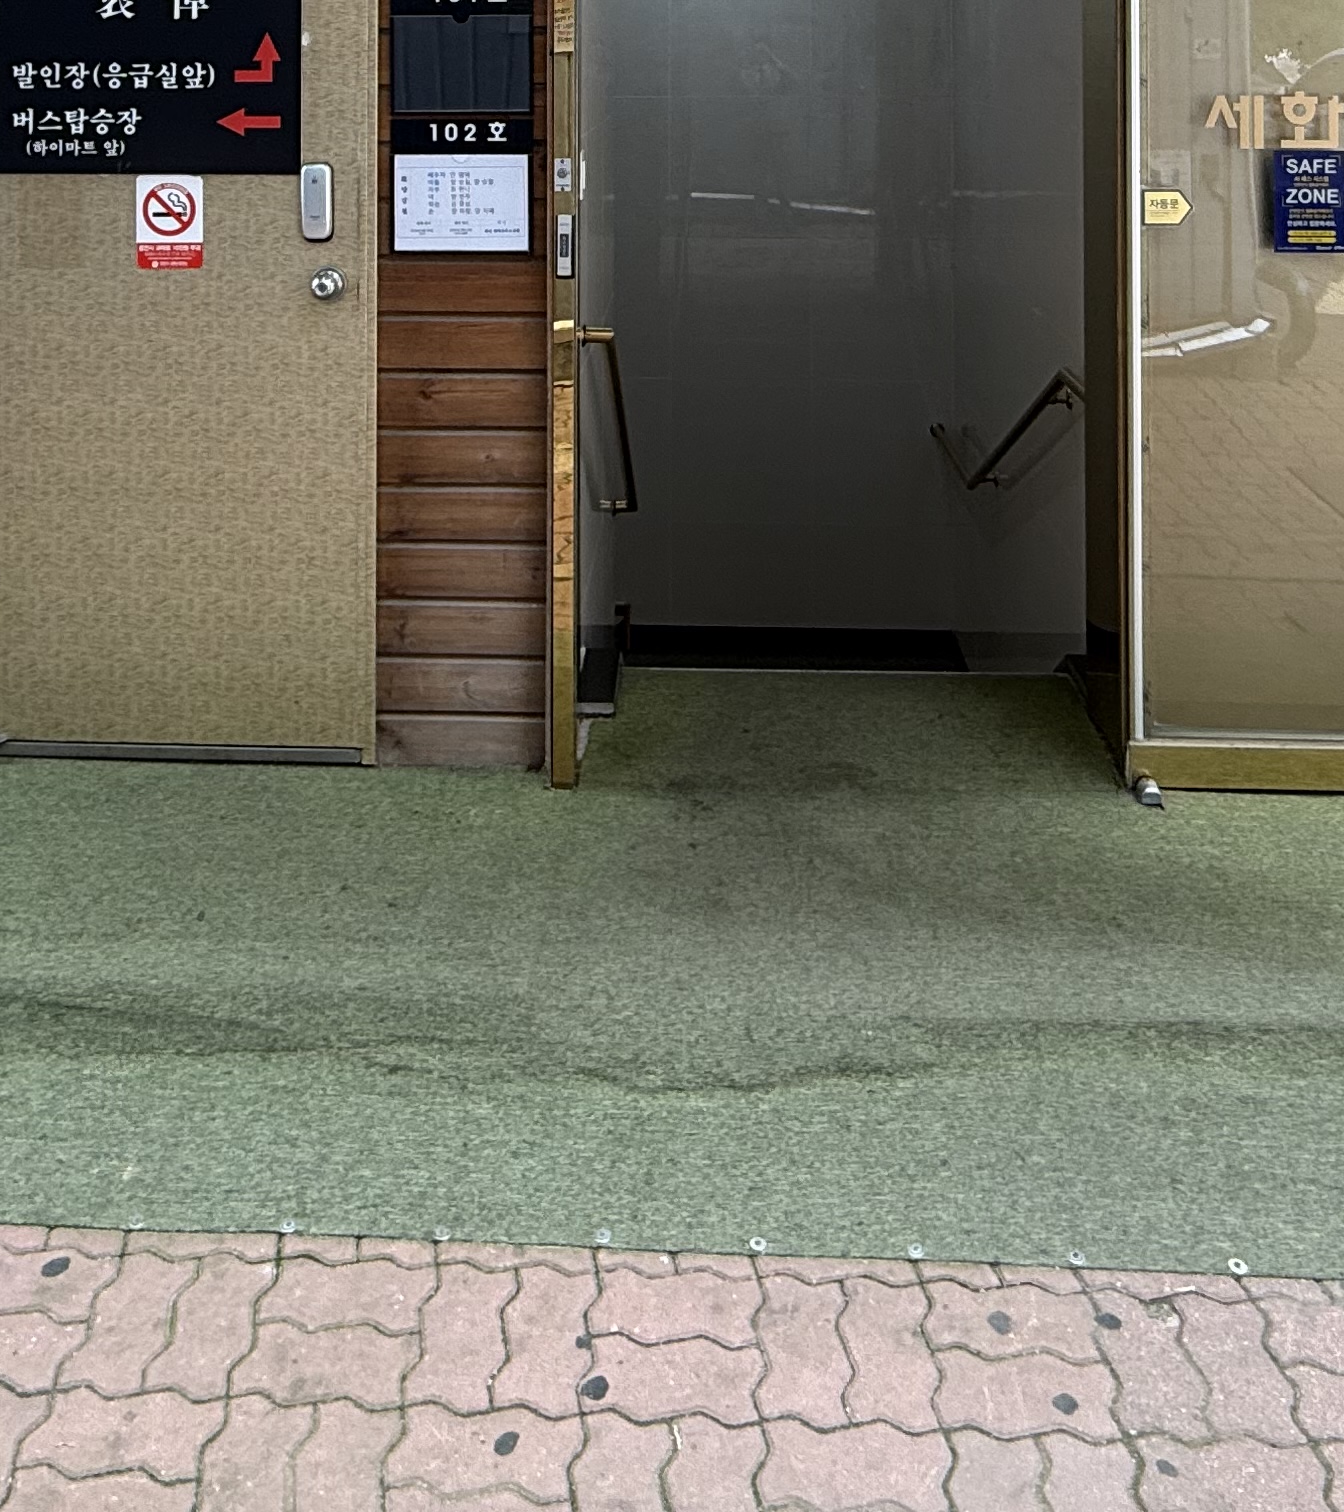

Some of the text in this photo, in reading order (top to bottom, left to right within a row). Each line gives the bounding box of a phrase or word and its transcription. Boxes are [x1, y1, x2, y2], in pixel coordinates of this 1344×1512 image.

[12, 61, 216, 90] 발인장(응급실앞)
[12, 107, 143, 136] 버스탑승장
[25, 139, 126, 157] (하이마트 앞)
[1286, 158, 1338, 174] SAFE
[1149, 198, 1179, 209] 자동문
[1285, 188, 1340, 204] ZONE
